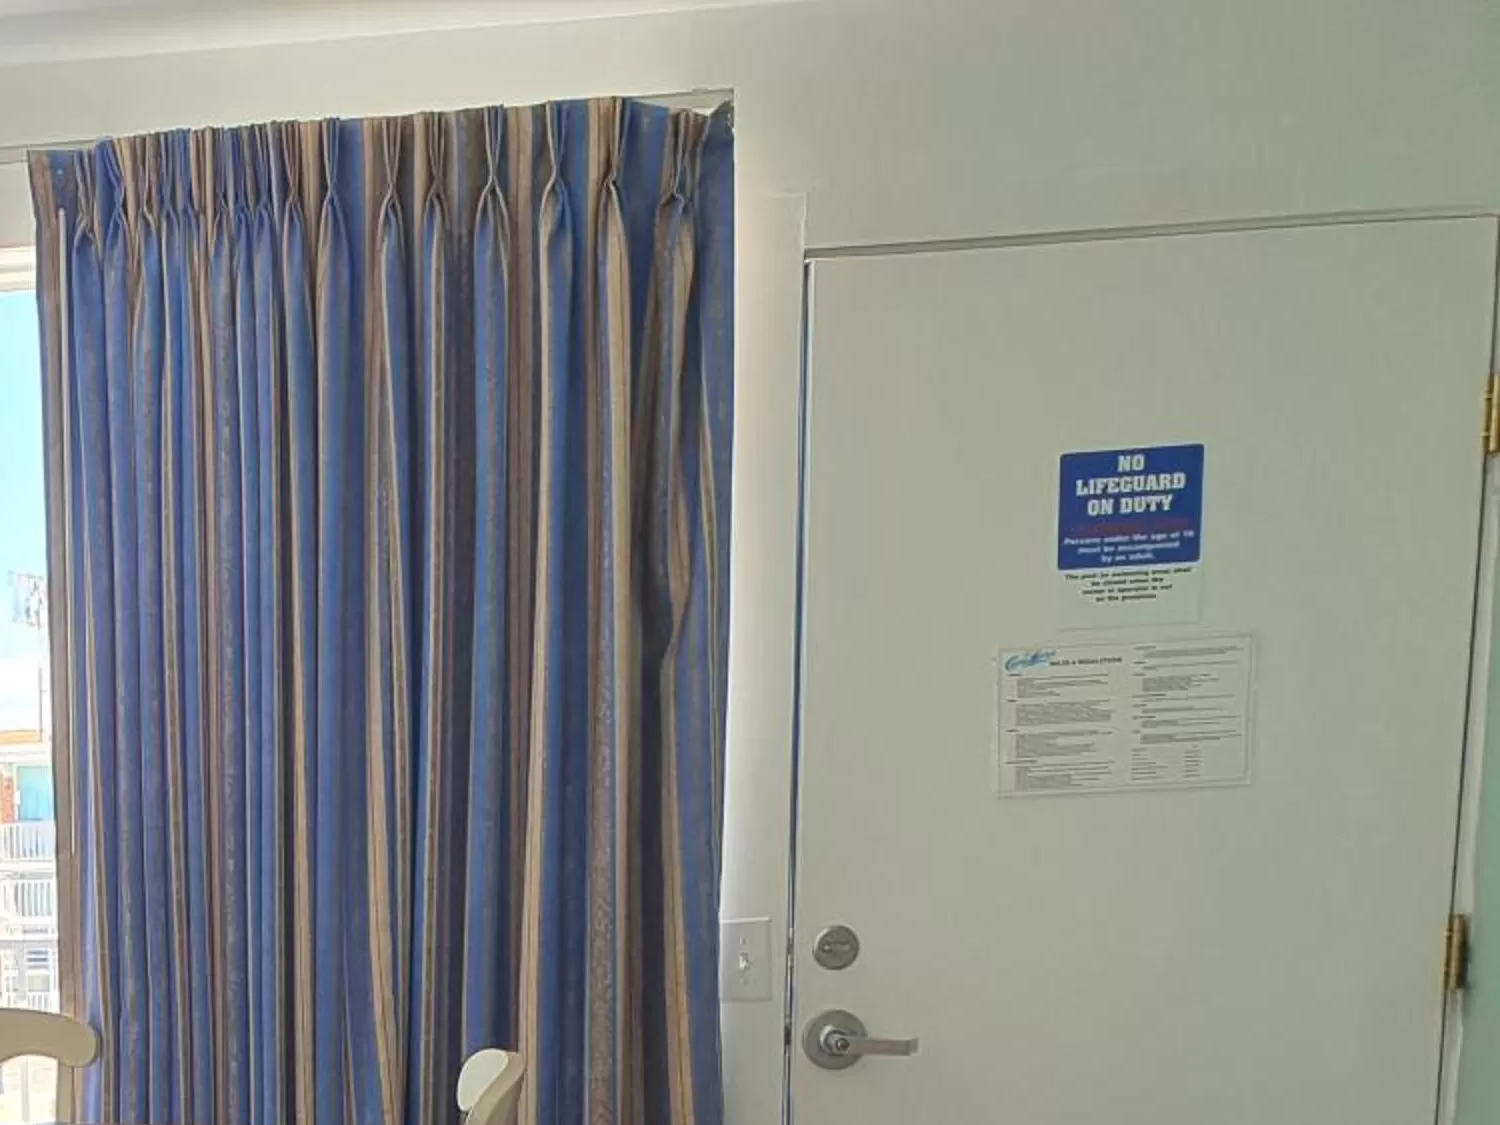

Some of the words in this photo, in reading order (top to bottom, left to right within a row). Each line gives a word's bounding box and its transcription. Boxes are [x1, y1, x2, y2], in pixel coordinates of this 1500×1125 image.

[1117, 454, 1145, 472] NO
[1075, 472, 1186, 496] LIFEGUARD
[1087, 498, 1113, 516] ON
[1119, 494, 1174, 514] DUTY
